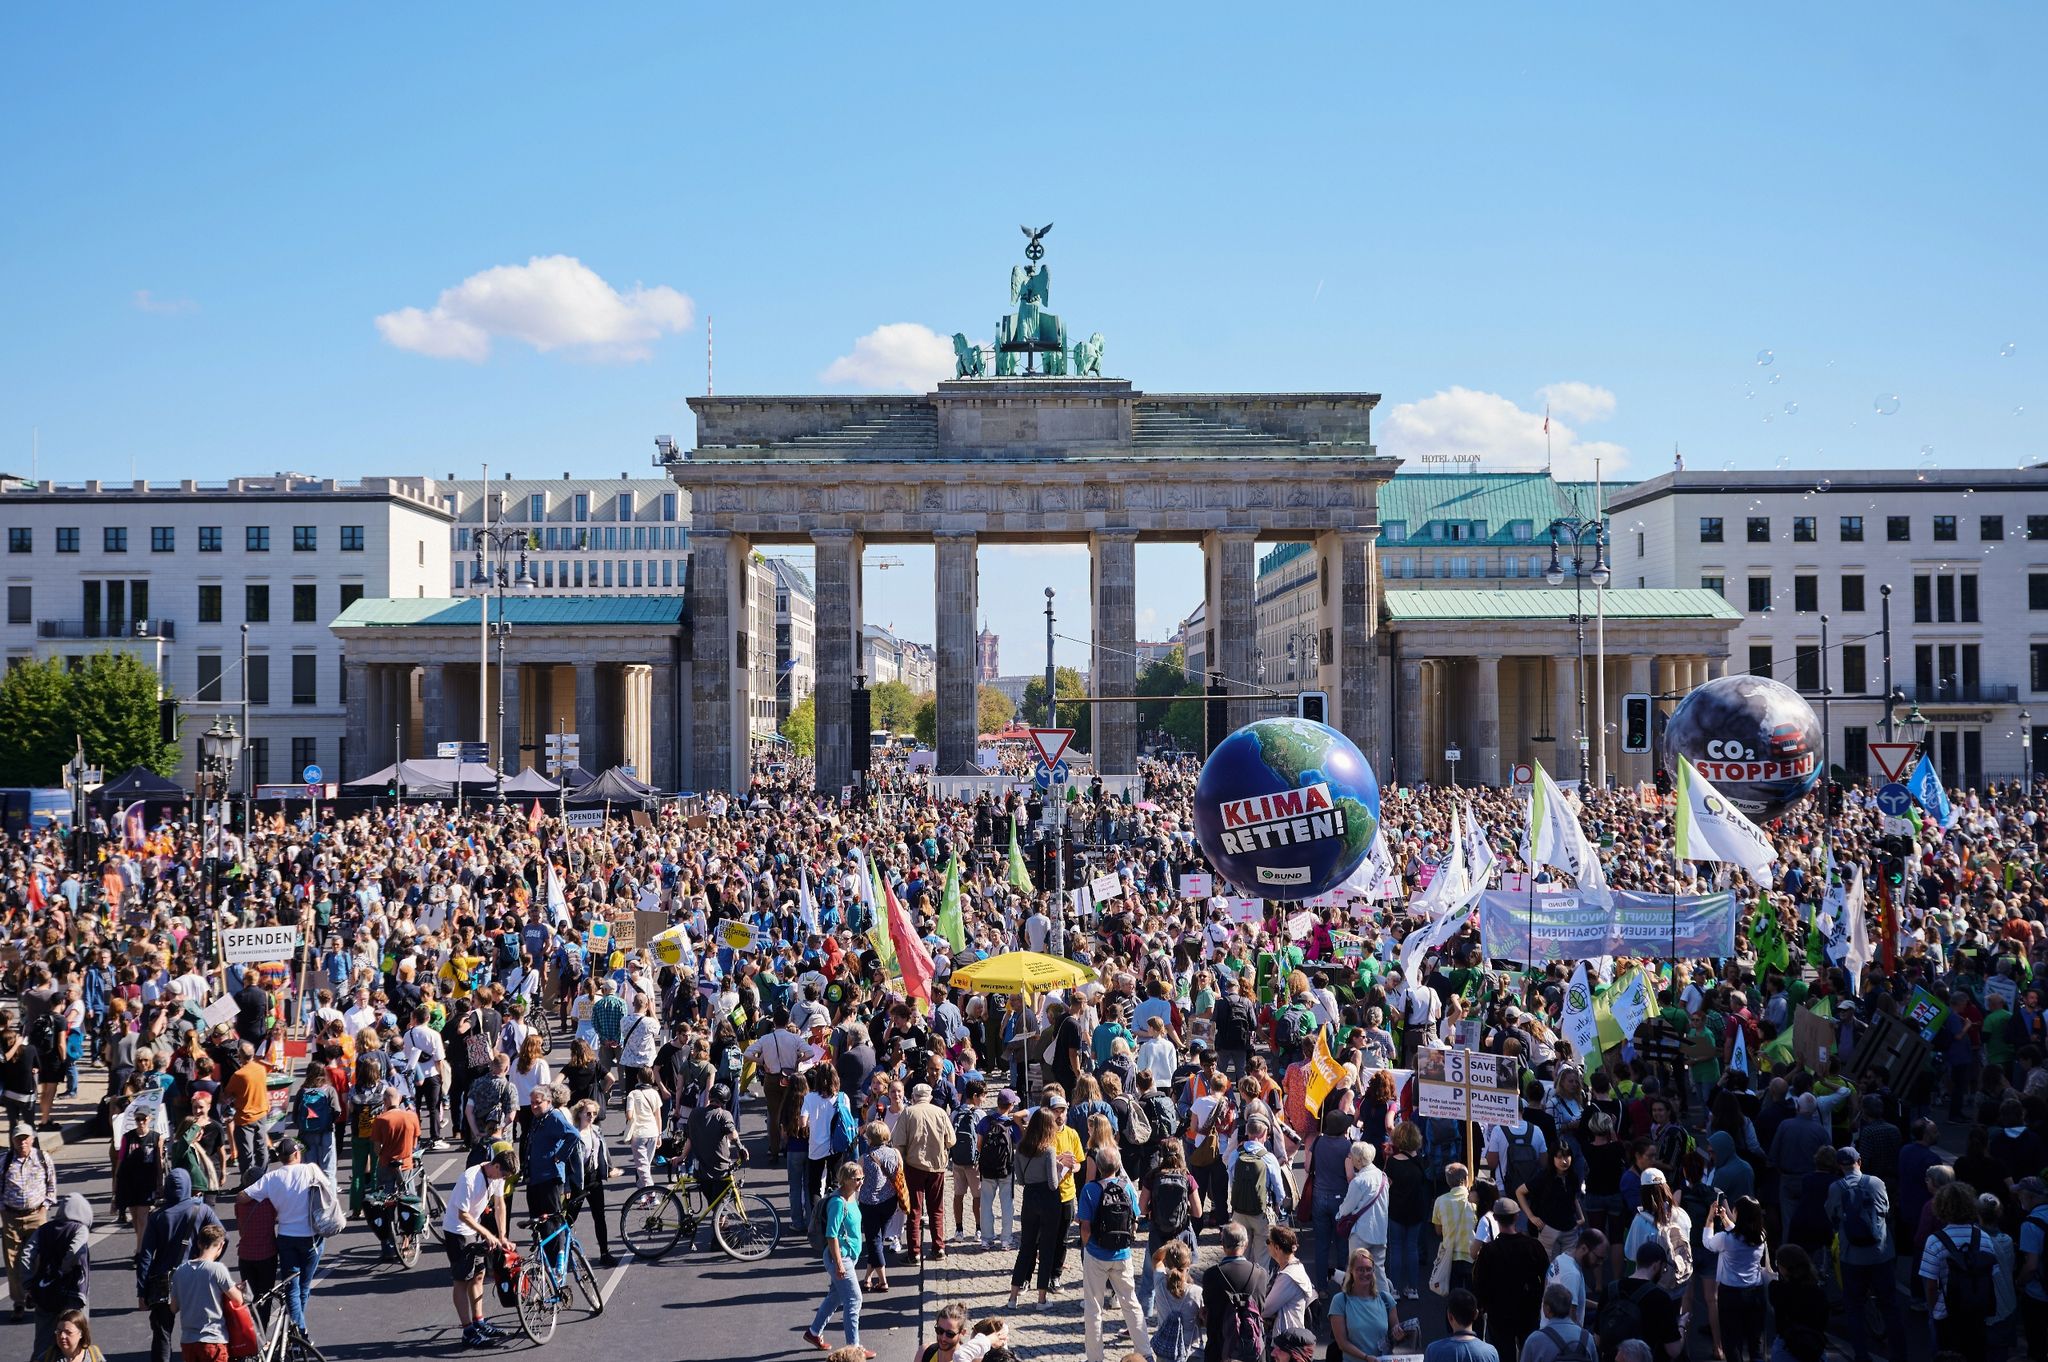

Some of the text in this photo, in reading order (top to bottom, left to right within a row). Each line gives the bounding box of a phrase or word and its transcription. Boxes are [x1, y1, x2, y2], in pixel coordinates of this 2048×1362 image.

[1422, 454, 1481, 463] HOTEL ADLON
[1696, 754, 1812, 781] STOPPEN!
[1223, 786, 1329, 827] KLIMA
[569, 812, 602, 821] SPENDEN
[1220, 811, 1345, 855] RETTEN!
[228, 932, 292, 947] SPENDEN
[1452, 1056, 1462, 1070] S
[1471, 1060, 1496, 1072] SAVE
[1452, 1070, 1464, 1083] O
[1471, 1073, 1493, 1084] OUR
[1453, 1088, 1463, 1100] P
[1471, 1092, 1510, 1105] PLANET
